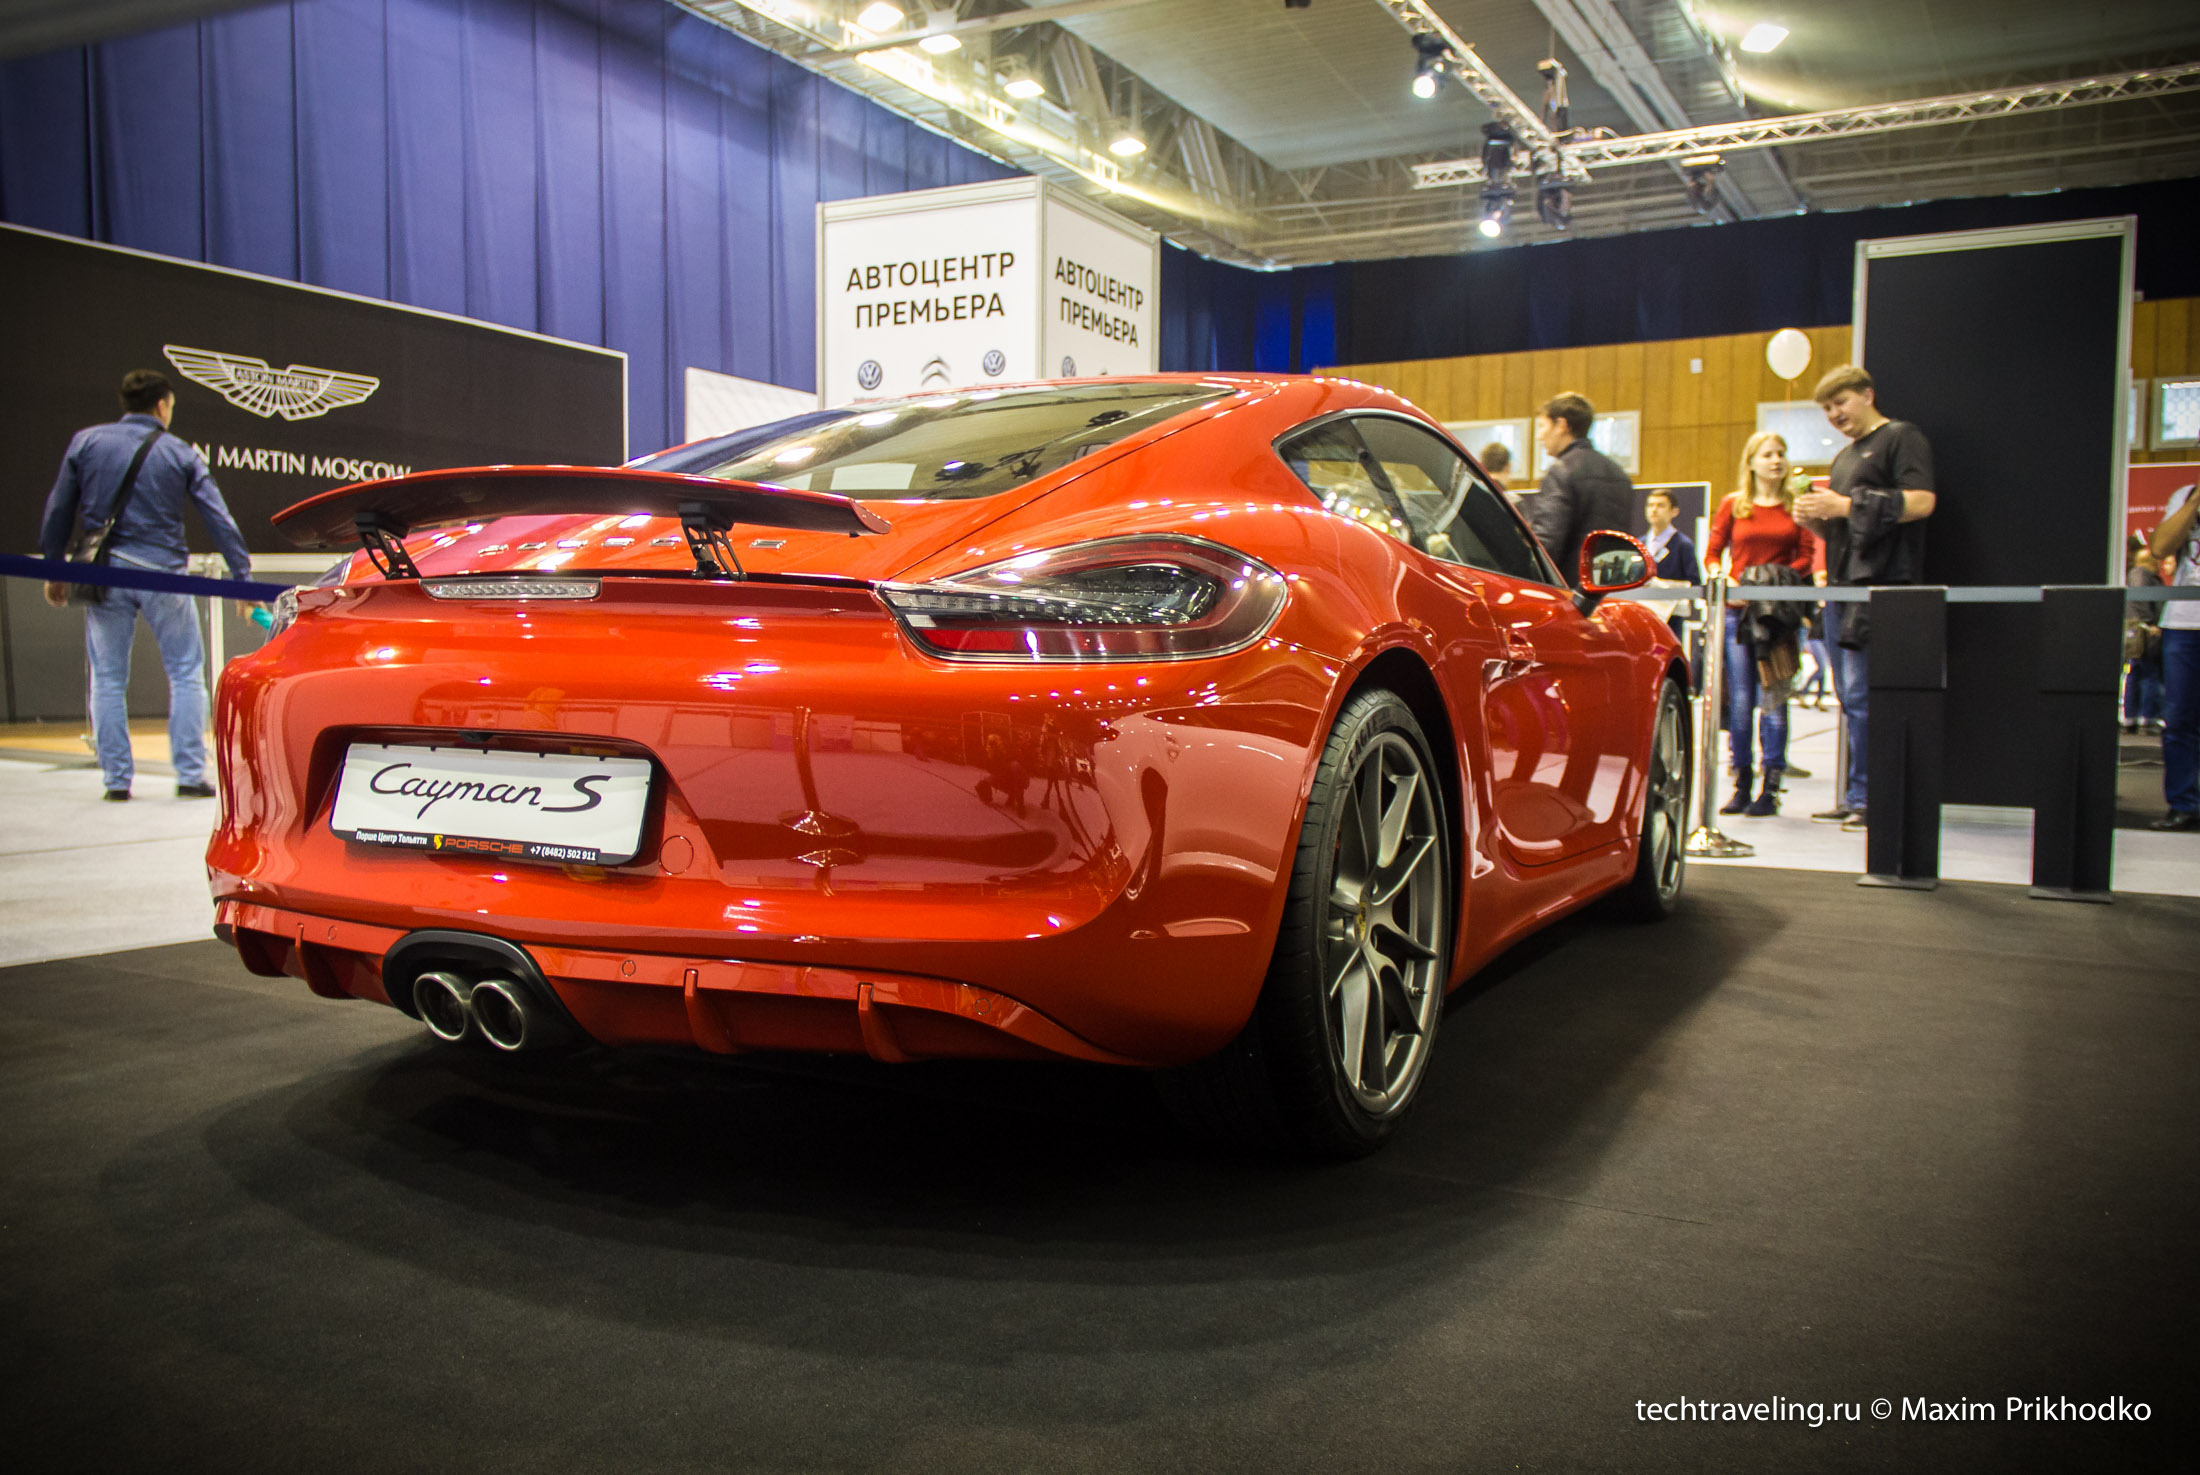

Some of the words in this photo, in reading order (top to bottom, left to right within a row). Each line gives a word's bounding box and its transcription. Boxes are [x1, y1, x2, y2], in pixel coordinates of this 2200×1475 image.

[846, 252, 1014, 292] АВТОЦЕНТР
[1055, 256, 1144, 312] АВТОЦЕНТР
[856, 292, 1005, 328] ПРЕМЬЕРА
[1060, 297, 1138, 348] ПРЕМЬЕРА
[235, 368, 275, 385] ASTON
[276, 374, 320, 392] MARTIN
[217, 444, 305, 475] MARTIN
[370, 763, 542, 819] Cayman
[540, 775, 612, 812] S
[356, 831, 377, 842] Порше
[378, 832, 397, 845] Центр
[398, 833, 427, 845] Тольятти
[445, 838, 524, 854] PORSCHE
[530, 846, 541, 855] +7
[541, 847, 566, 859] (8482)
[567, 849, 581, 859] 502
[582, 851, 596, 861] 911
